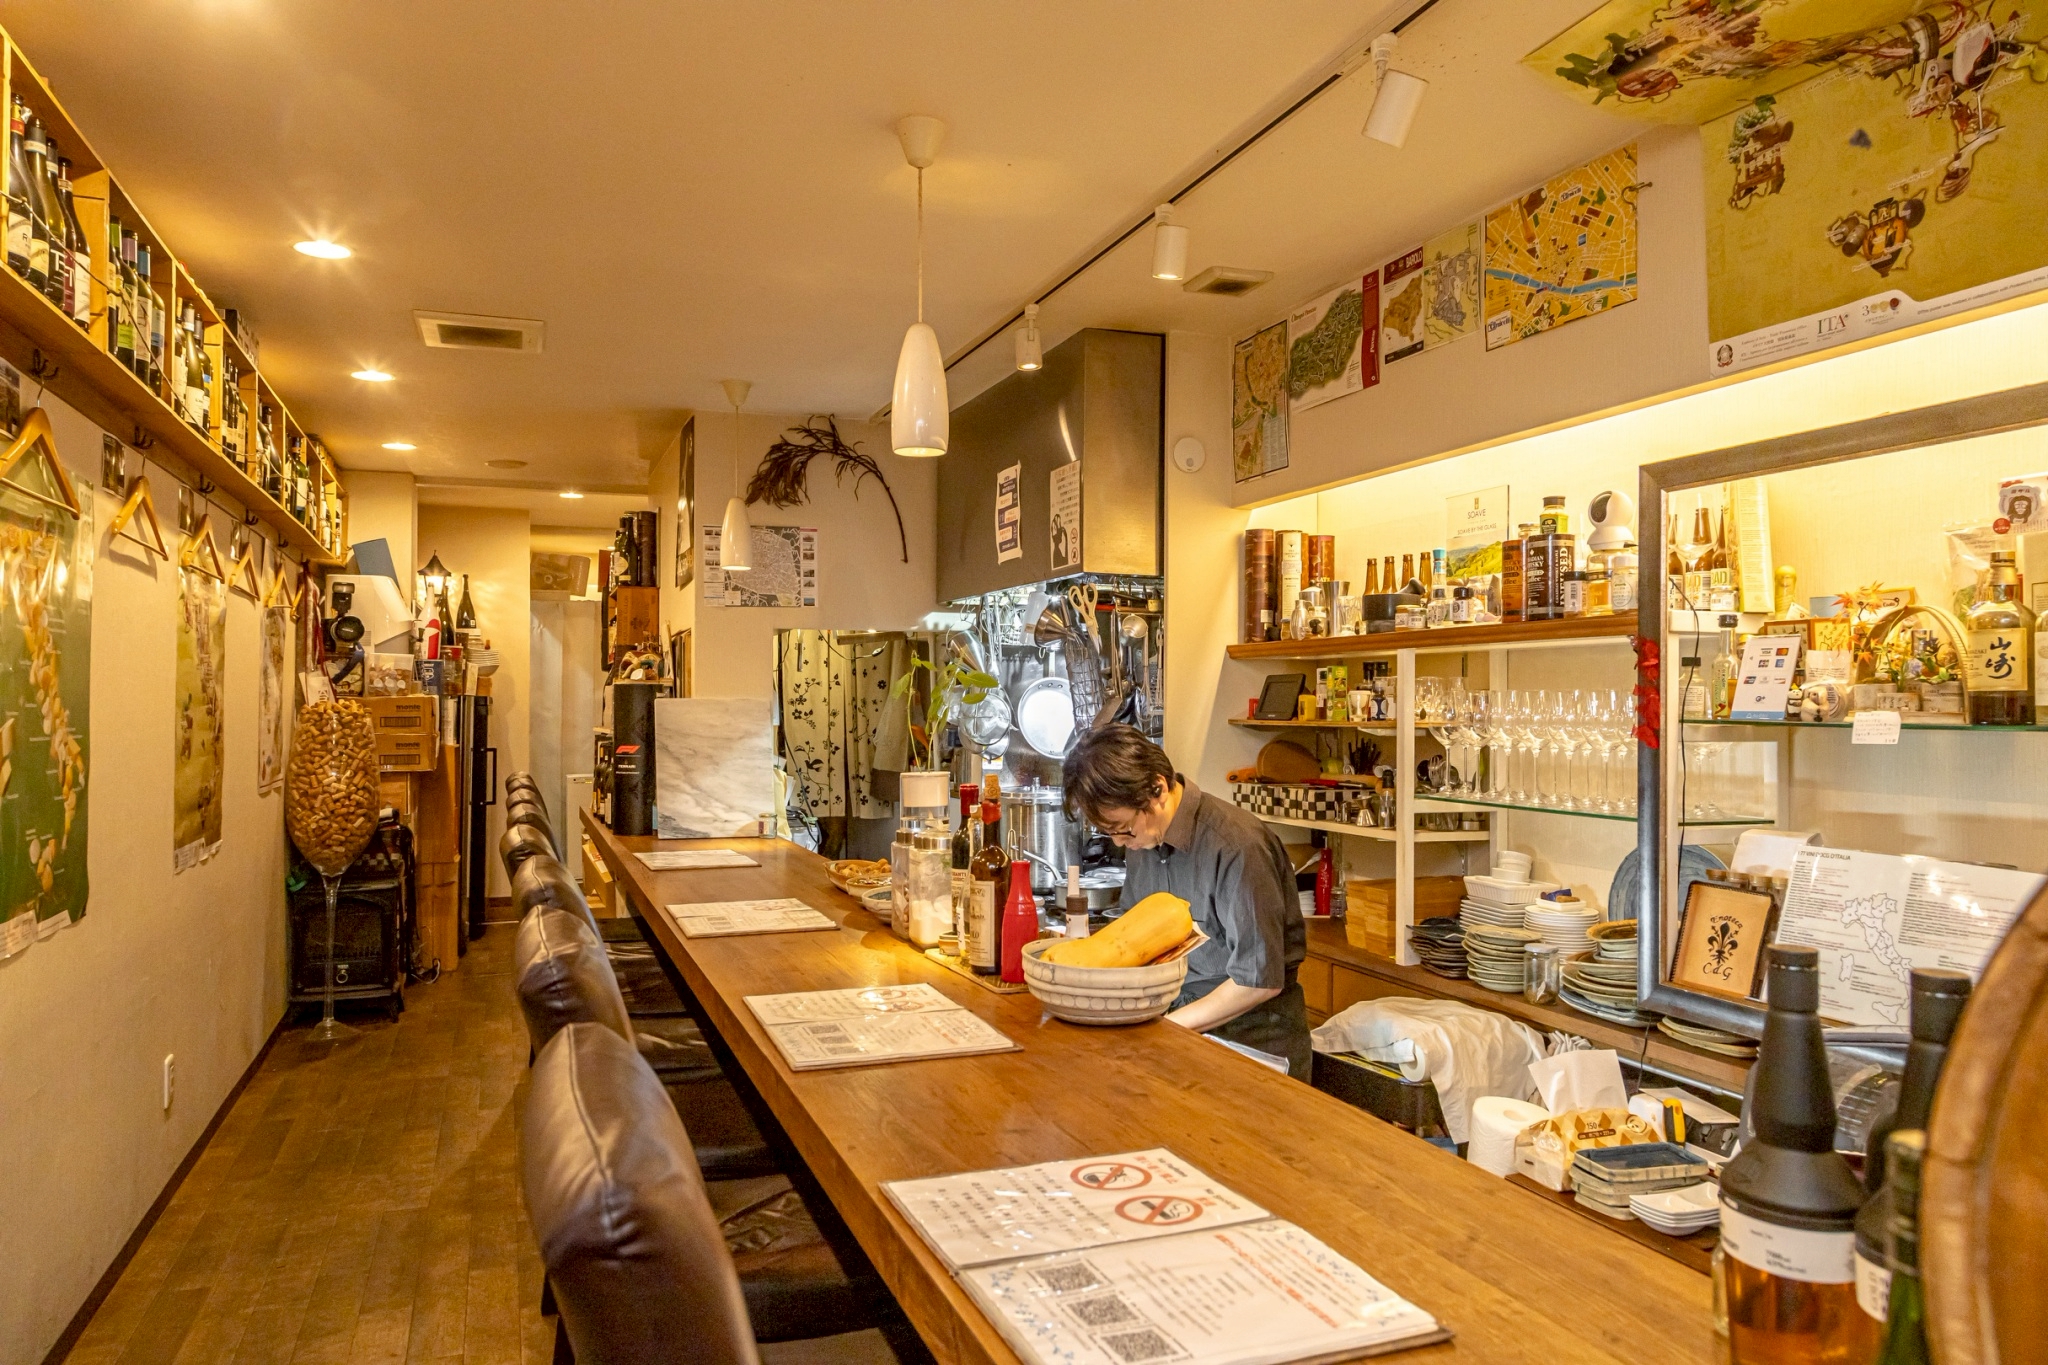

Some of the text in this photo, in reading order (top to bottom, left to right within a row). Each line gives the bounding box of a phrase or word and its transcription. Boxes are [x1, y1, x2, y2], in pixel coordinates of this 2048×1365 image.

[1406, 250, 1423, 268] BAROLO
[1817, 314, 1847, 335] ITA
[1467, 509, 1487, 520] SOAVE
[1710, 915, 1743, 930] Enoteca
